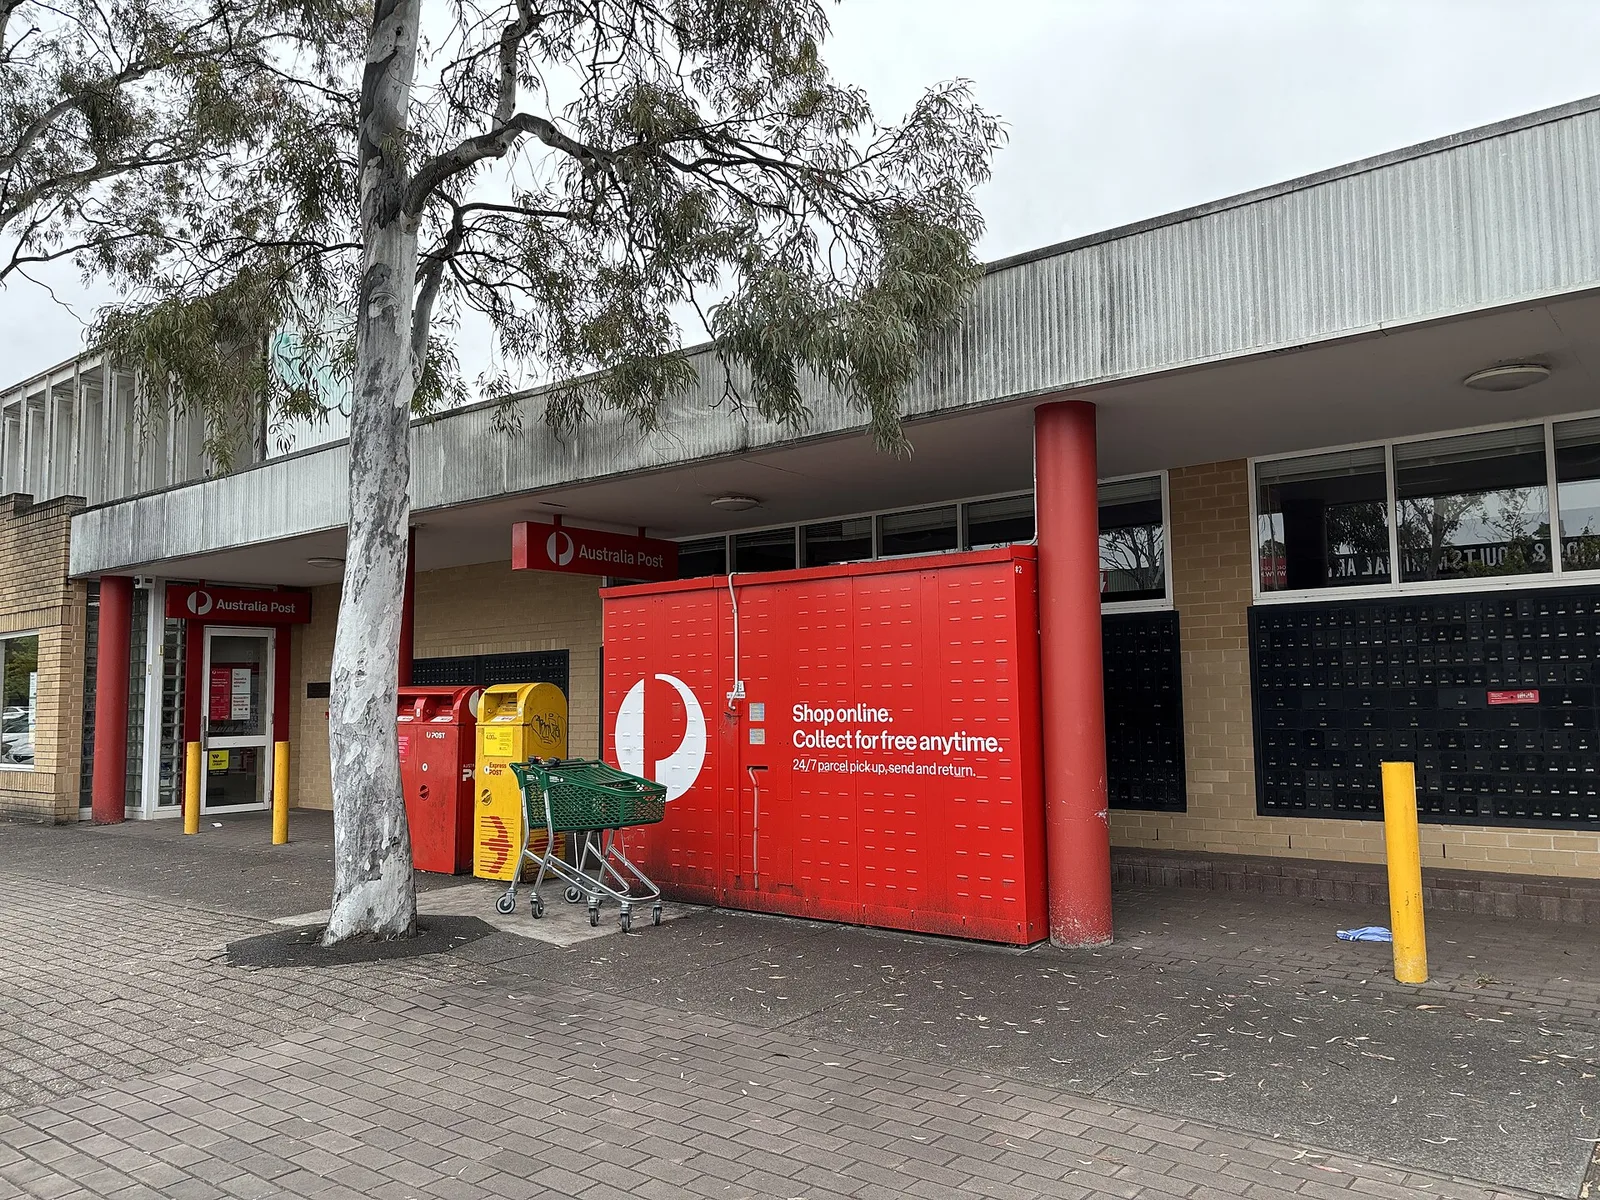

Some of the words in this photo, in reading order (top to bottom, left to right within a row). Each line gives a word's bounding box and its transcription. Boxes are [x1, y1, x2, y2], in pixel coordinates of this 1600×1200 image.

[579, 544, 634, 565] Australia
[637, 551, 663, 568] Post
[216, 599, 268, 612] Australia
[271, 602, 296, 613] Post
[792, 703, 834, 726] Shop
[836, 703, 893, 723] online.
[431, 731, 446, 739] POST
[792, 729, 853, 749] Collect
[855, 729, 879, 749] for
[881, 730, 917, 750] free
[919, 731, 1004, 755] anytime.
[489, 761, 507, 769] Express
[793, 758, 817, 772] 24/7
[818, 760, 849, 773] parcel
[888, 762, 915, 774] send
[915, 762, 937, 775] and
[938, 763, 976, 777] return.
